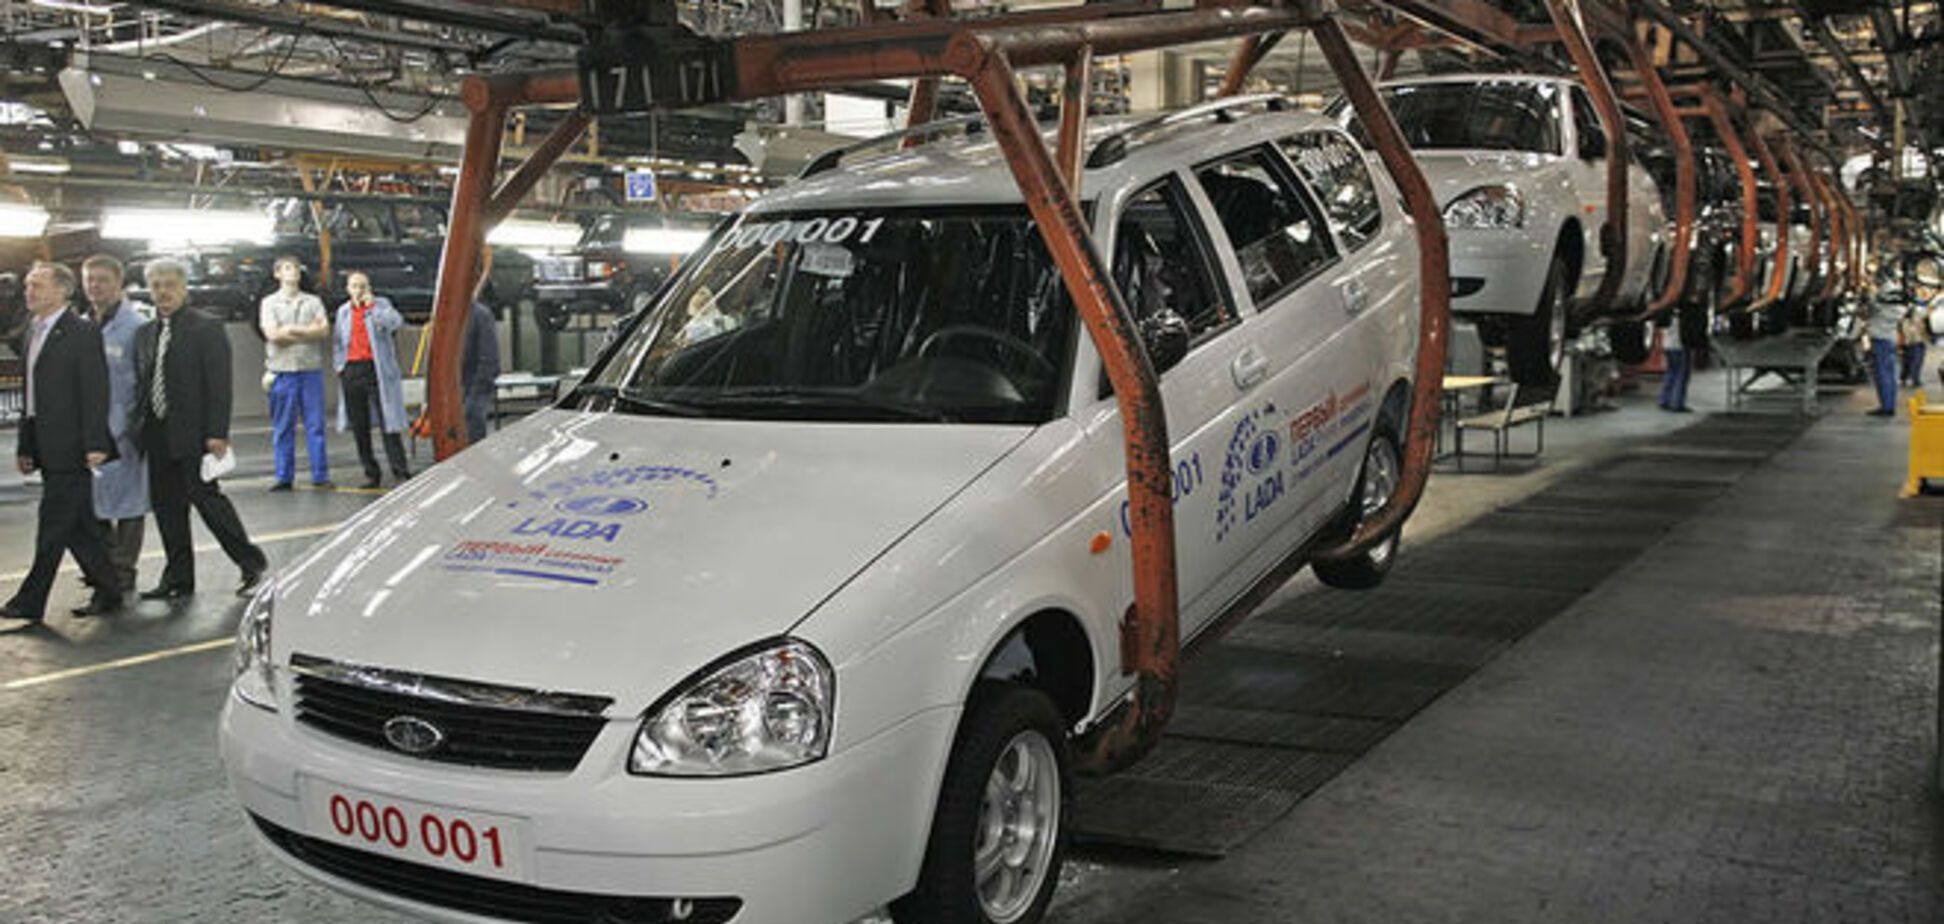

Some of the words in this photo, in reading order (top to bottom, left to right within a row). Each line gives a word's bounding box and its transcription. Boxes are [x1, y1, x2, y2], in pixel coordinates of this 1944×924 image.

[800, 217, 885, 243] 001
[1245, 470, 1285, 522] LADA
[511, 517, 622, 542] LADA
[330, 794, 408, 849] 000
[420, 813, 504, 868] 001
